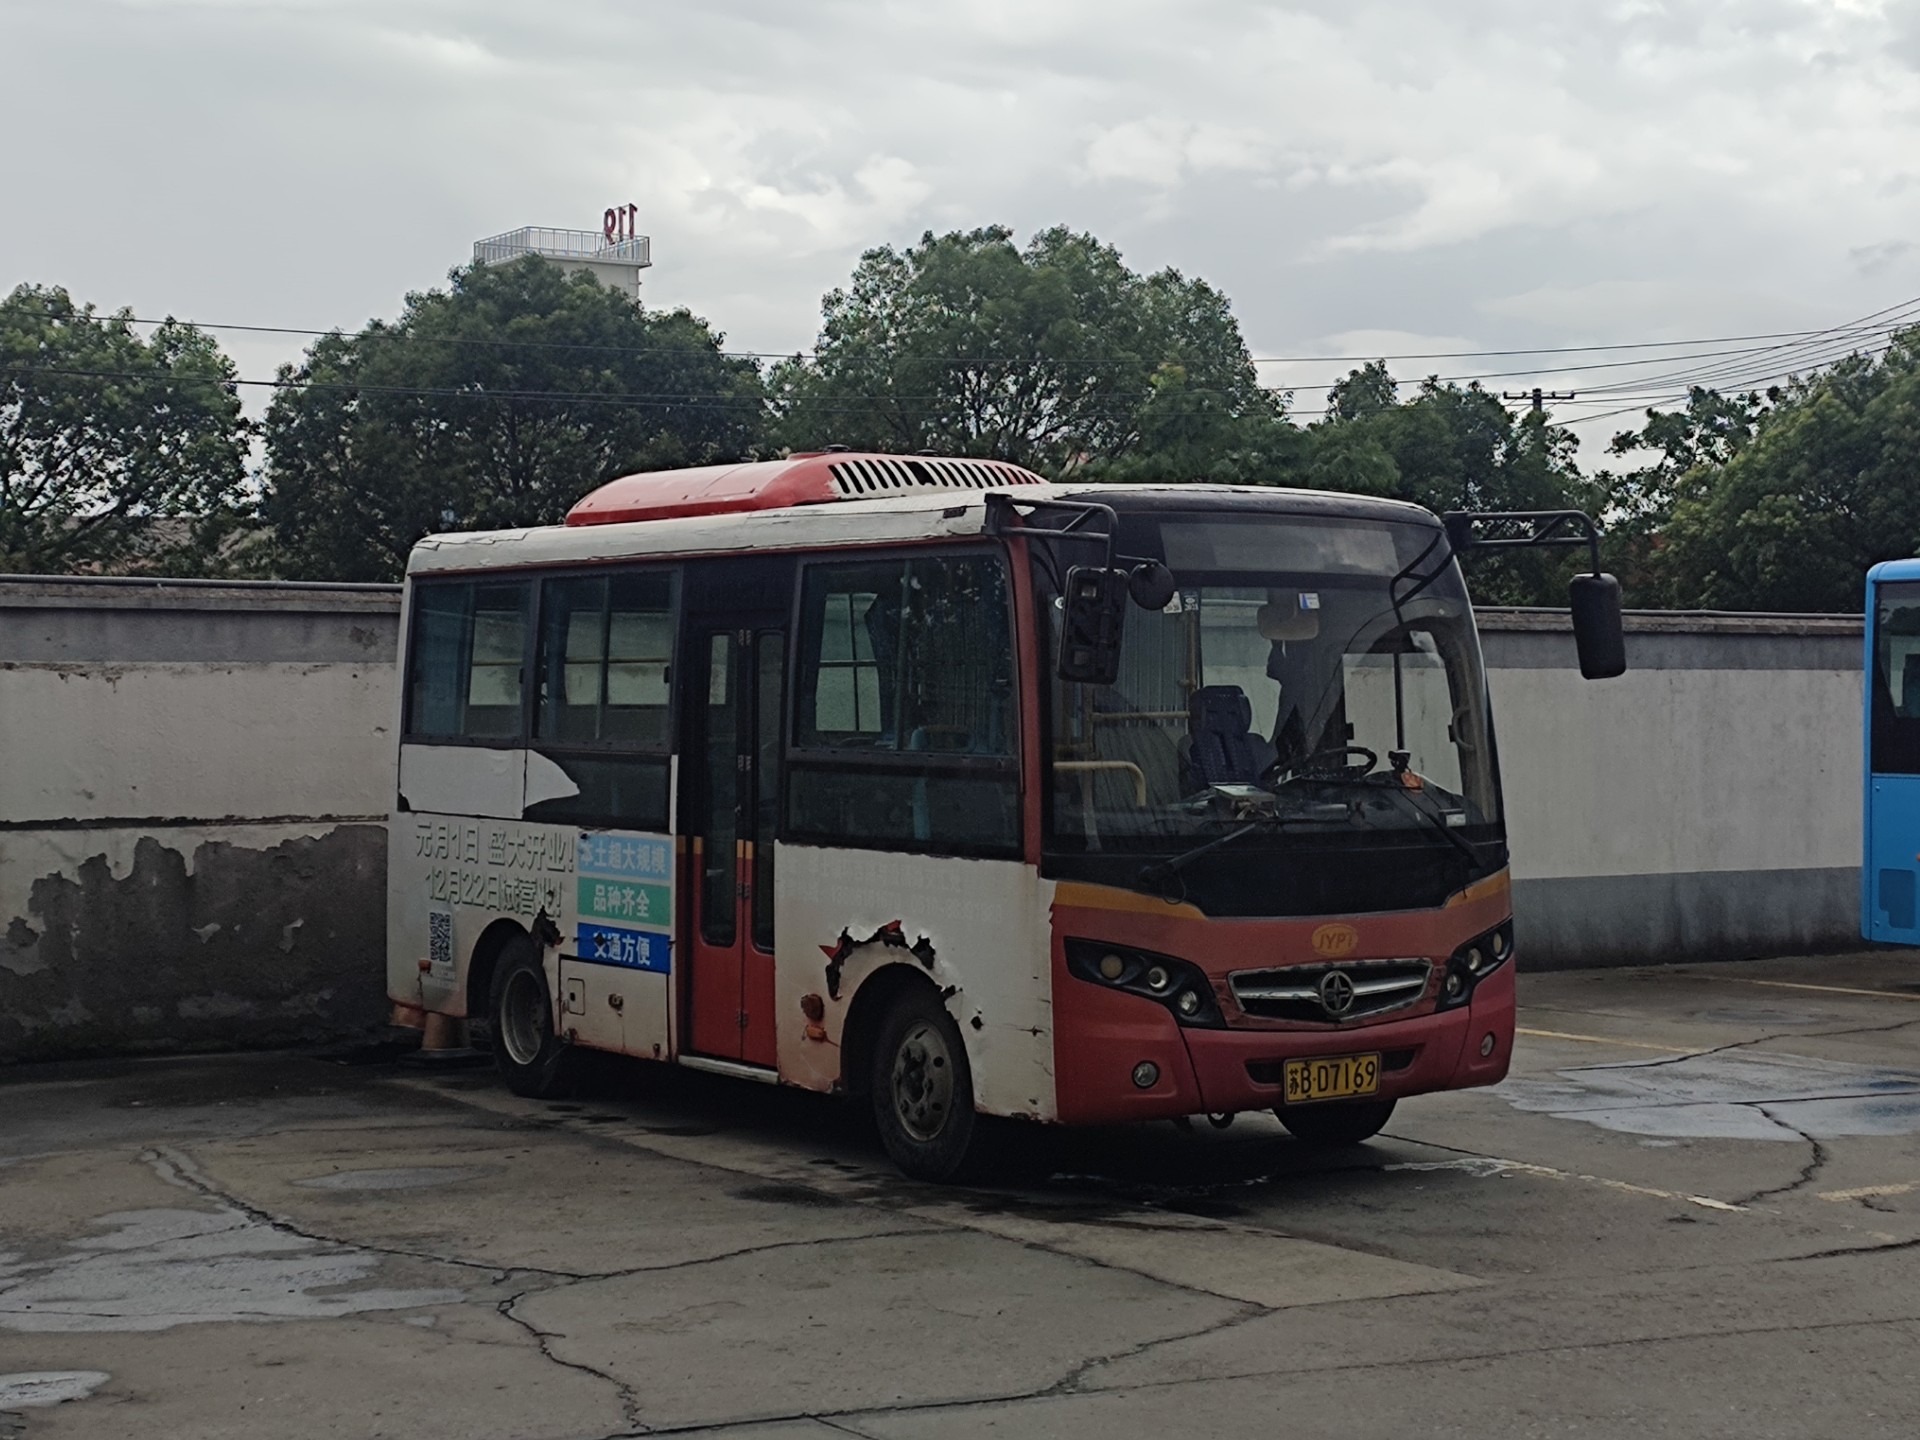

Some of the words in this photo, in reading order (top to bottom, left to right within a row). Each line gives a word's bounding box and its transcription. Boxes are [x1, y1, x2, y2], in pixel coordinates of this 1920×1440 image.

[416, 823, 480, 865] 元月1日
[593, 885, 650, 917] 品种齐全
[594, 932, 651, 968] 交通方便
